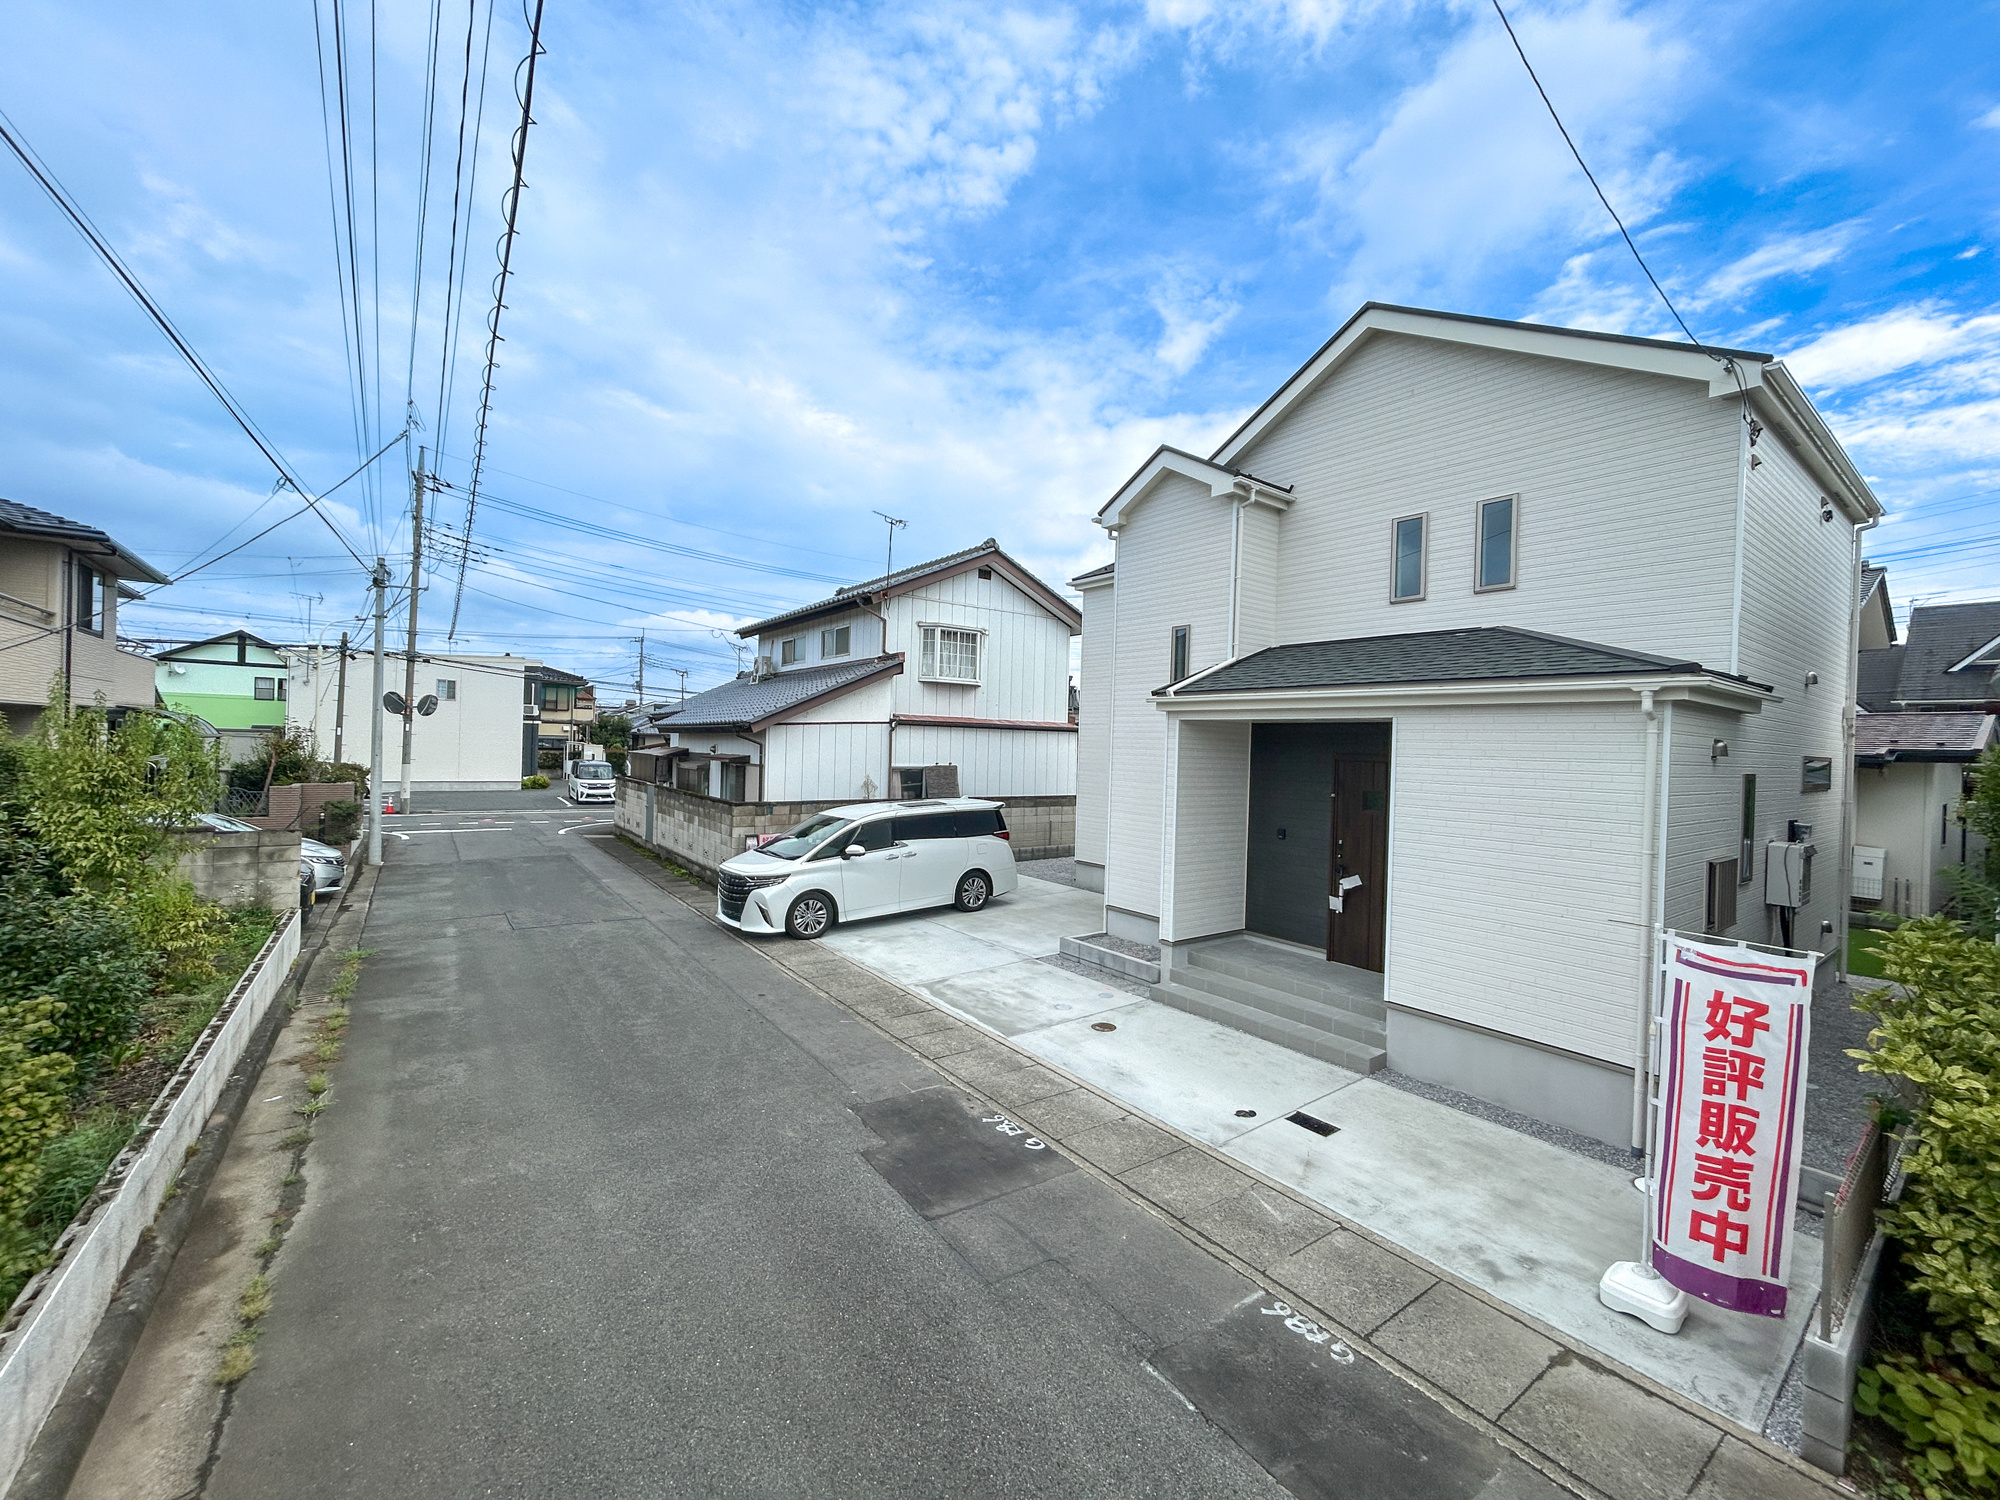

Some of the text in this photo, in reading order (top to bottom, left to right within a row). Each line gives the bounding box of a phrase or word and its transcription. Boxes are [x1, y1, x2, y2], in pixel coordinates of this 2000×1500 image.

[1688, 989, 1770, 1264] 好評販売中
